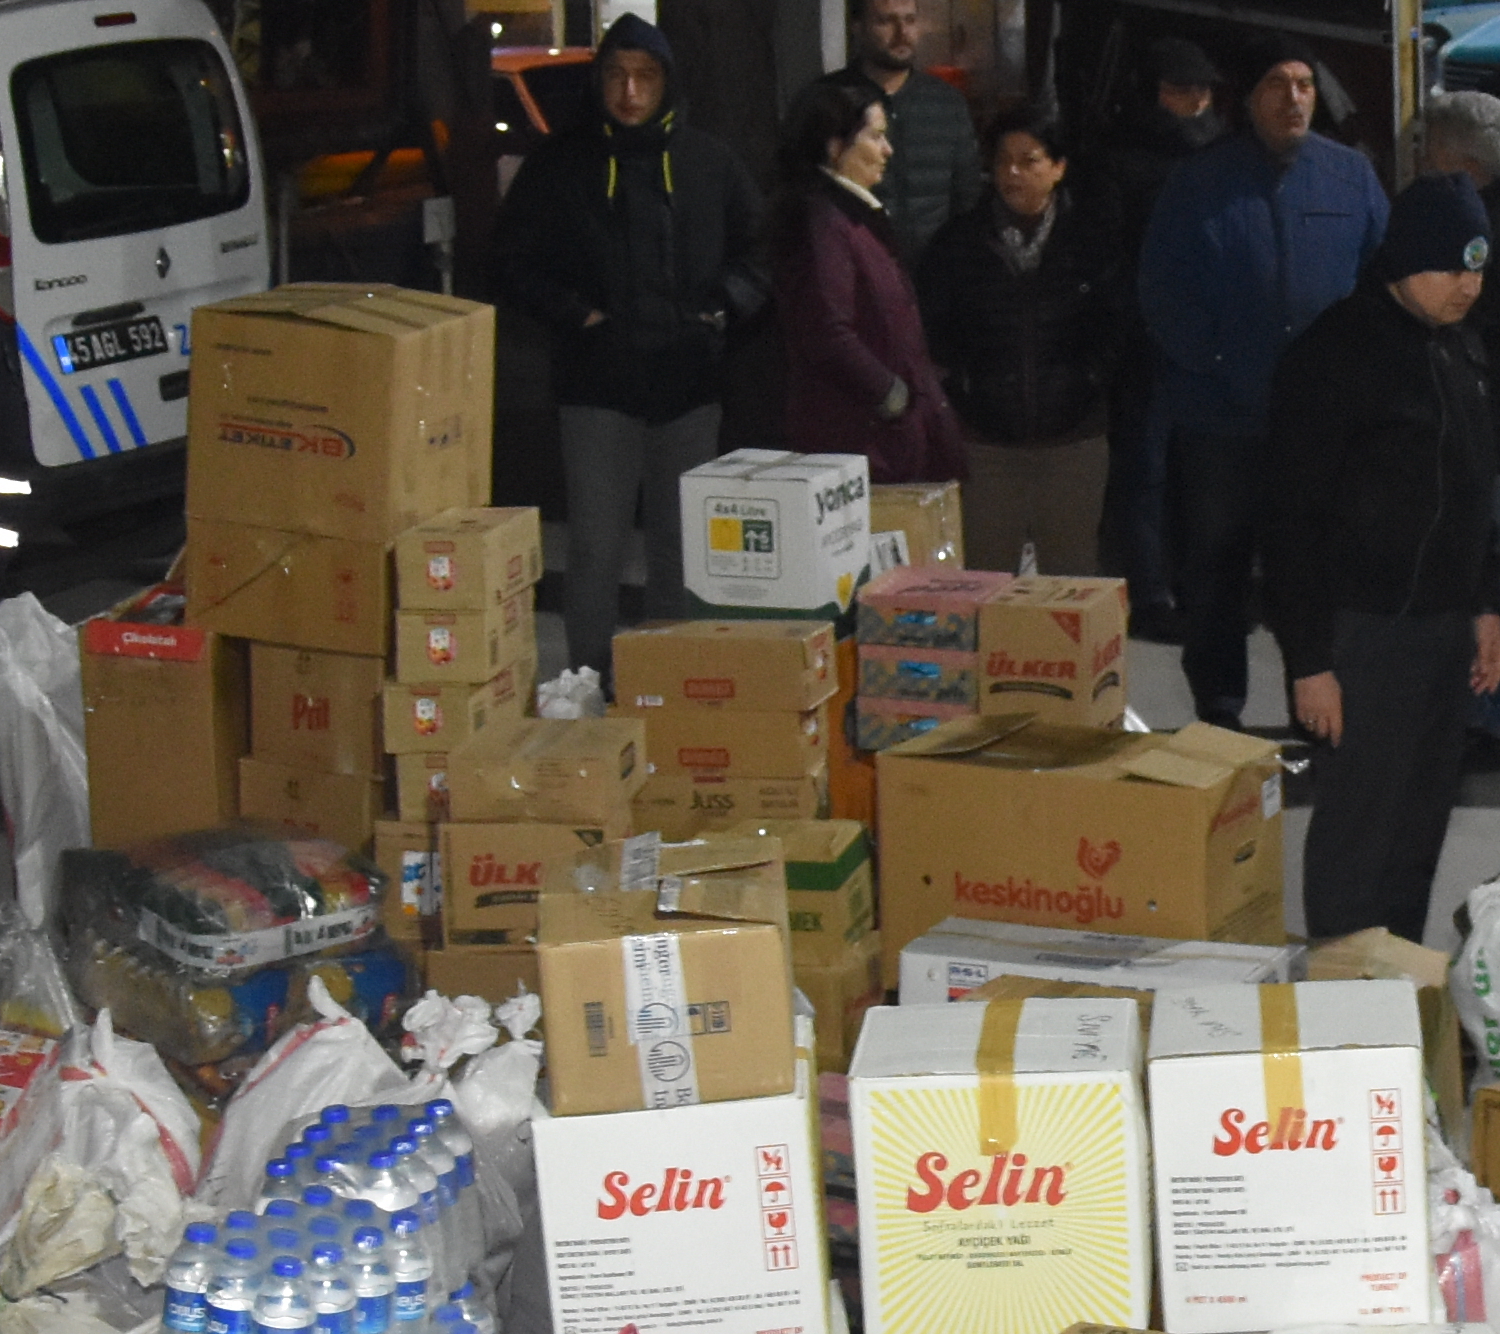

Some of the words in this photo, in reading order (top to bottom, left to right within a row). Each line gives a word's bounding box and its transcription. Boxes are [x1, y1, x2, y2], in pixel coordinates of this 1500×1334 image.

[128, 322, 165, 352] 592
[986, 650, 1077, 679] ÜLKER
[469, 854, 542, 887] ÜLK
[955, 871, 1125, 923] keskinoğlu
[1212, 1107, 1339, 1156] Selin
[596, 1167, 727, 1219] Selin
[906, 1151, 1068, 1213] Selin
